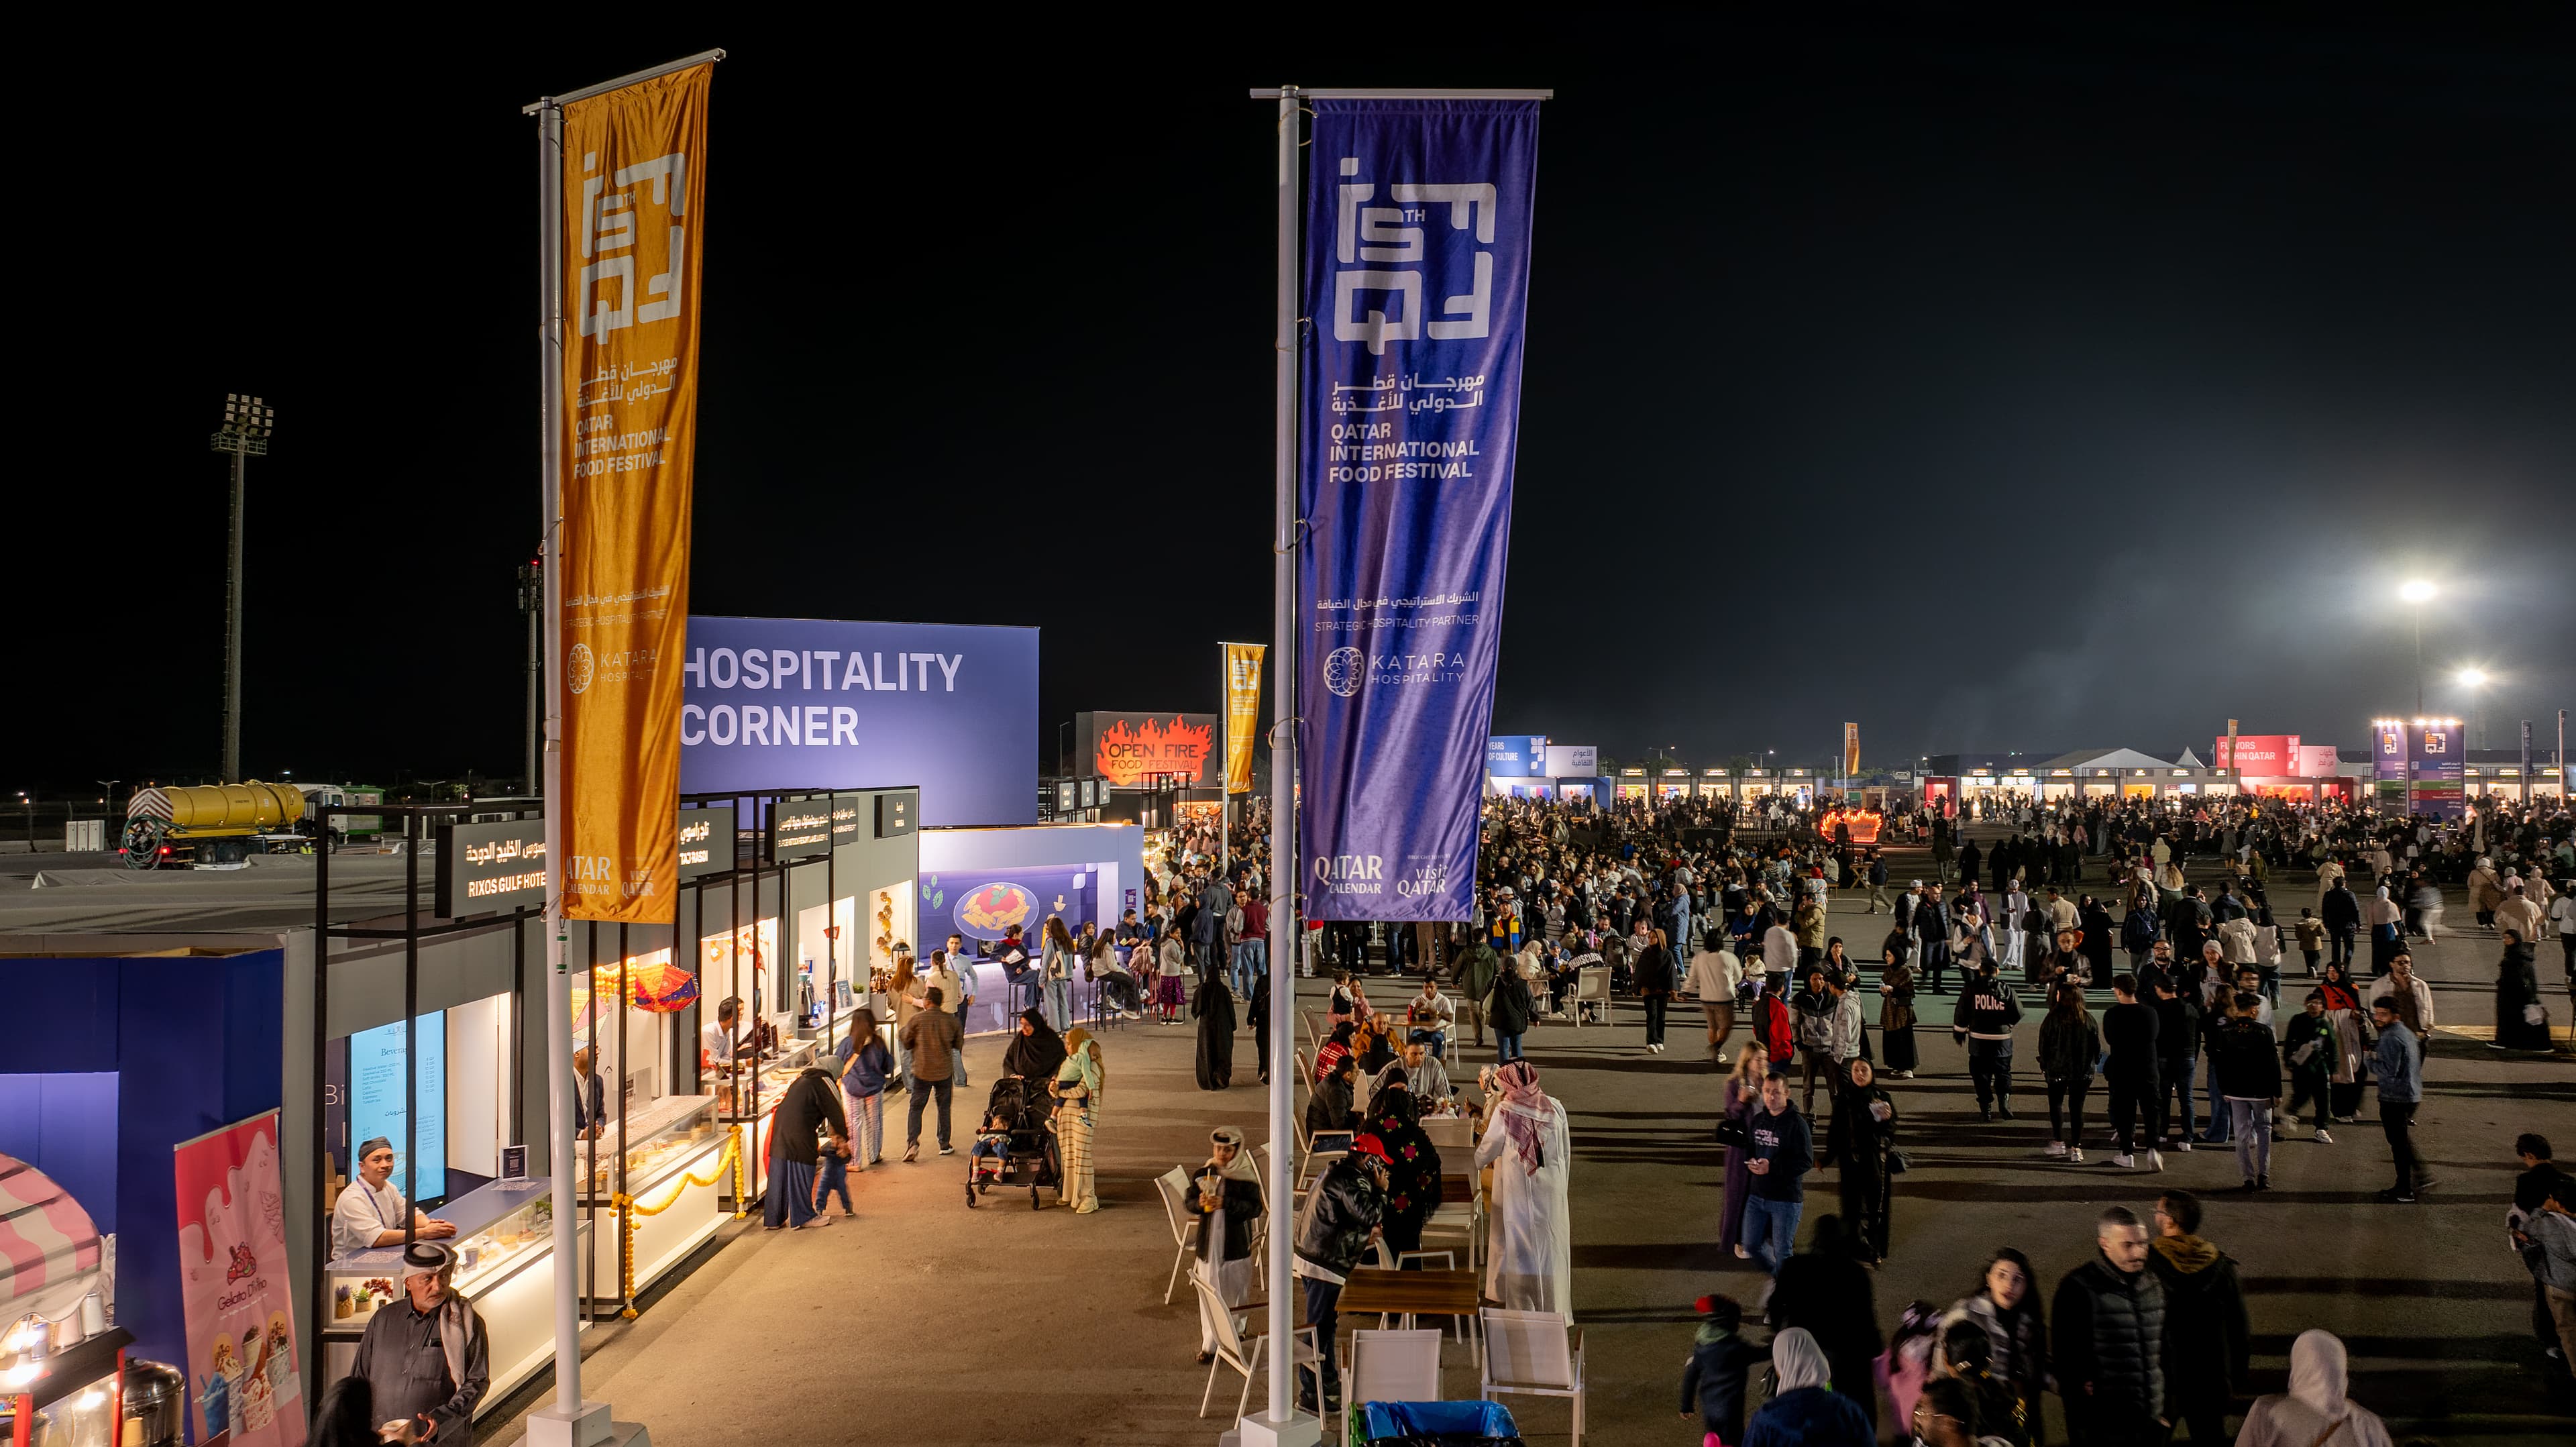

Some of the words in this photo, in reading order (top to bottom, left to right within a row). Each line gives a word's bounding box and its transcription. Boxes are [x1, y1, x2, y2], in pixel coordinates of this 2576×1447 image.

[576, 414, 612, 439] QATAR
[1331, 423, 1391, 444] QATAR
[574, 427, 671, 459] INTERNATIONAL
[1330, 441, 1479, 462] INTERNATIONAL
[574, 457, 604, 479] FOOD
[605, 449, 665, 474] FESTIVAL
[1330, 466, 1381, 483] FOOD
[1385, 462, 1472, 480] FESTIVAL
[1432, 614, 1479, 627] PARTNER
[682, 647, 963, 692] HOSPITALITY
[1371, 653, 1465, 670] KATARA
[1371, 672, 1465, 684] HOSPITALITY
[680, 704, 859, 746] CORNER
[1108, 743, 1155, 759] OPEN
[1165, 744, 1199, 758] FIRE
[1489, 741, 1505, 751] YEARS
[2220, 741, 2256, 750] FLVORS
[1112, 759, 1142, 769] FOOD
[1148, 759, 1197, 770] FESTIVAL
[1488, 752, 1495, 761] OF
[1495, 752, 1519, 761] CULTURE
[2220, 752, 2247, 760] WHIN
[2249, 752, 2275, 761] QATAR
[566, 855, 611, 881] ATAR
[1314, 855, 1383, 886] QATAR
[1415, 864, 1448, 879] visit
[468, 877, 498, 898] RIXOS
[498, 873, 523, 894] GULF
[523, 871, 546, 890] HOTE
[567, 883, 610, 895] CALENDAR
[622, 881, 655, 899] QATAR
[1329, 883, 1382, 894] CALENDAR
[1397, 879, 1446, 898] QATAR
[1974, 994, 2005, 1010] POLICE
[218, 1291, 246, 1310] Gelato
